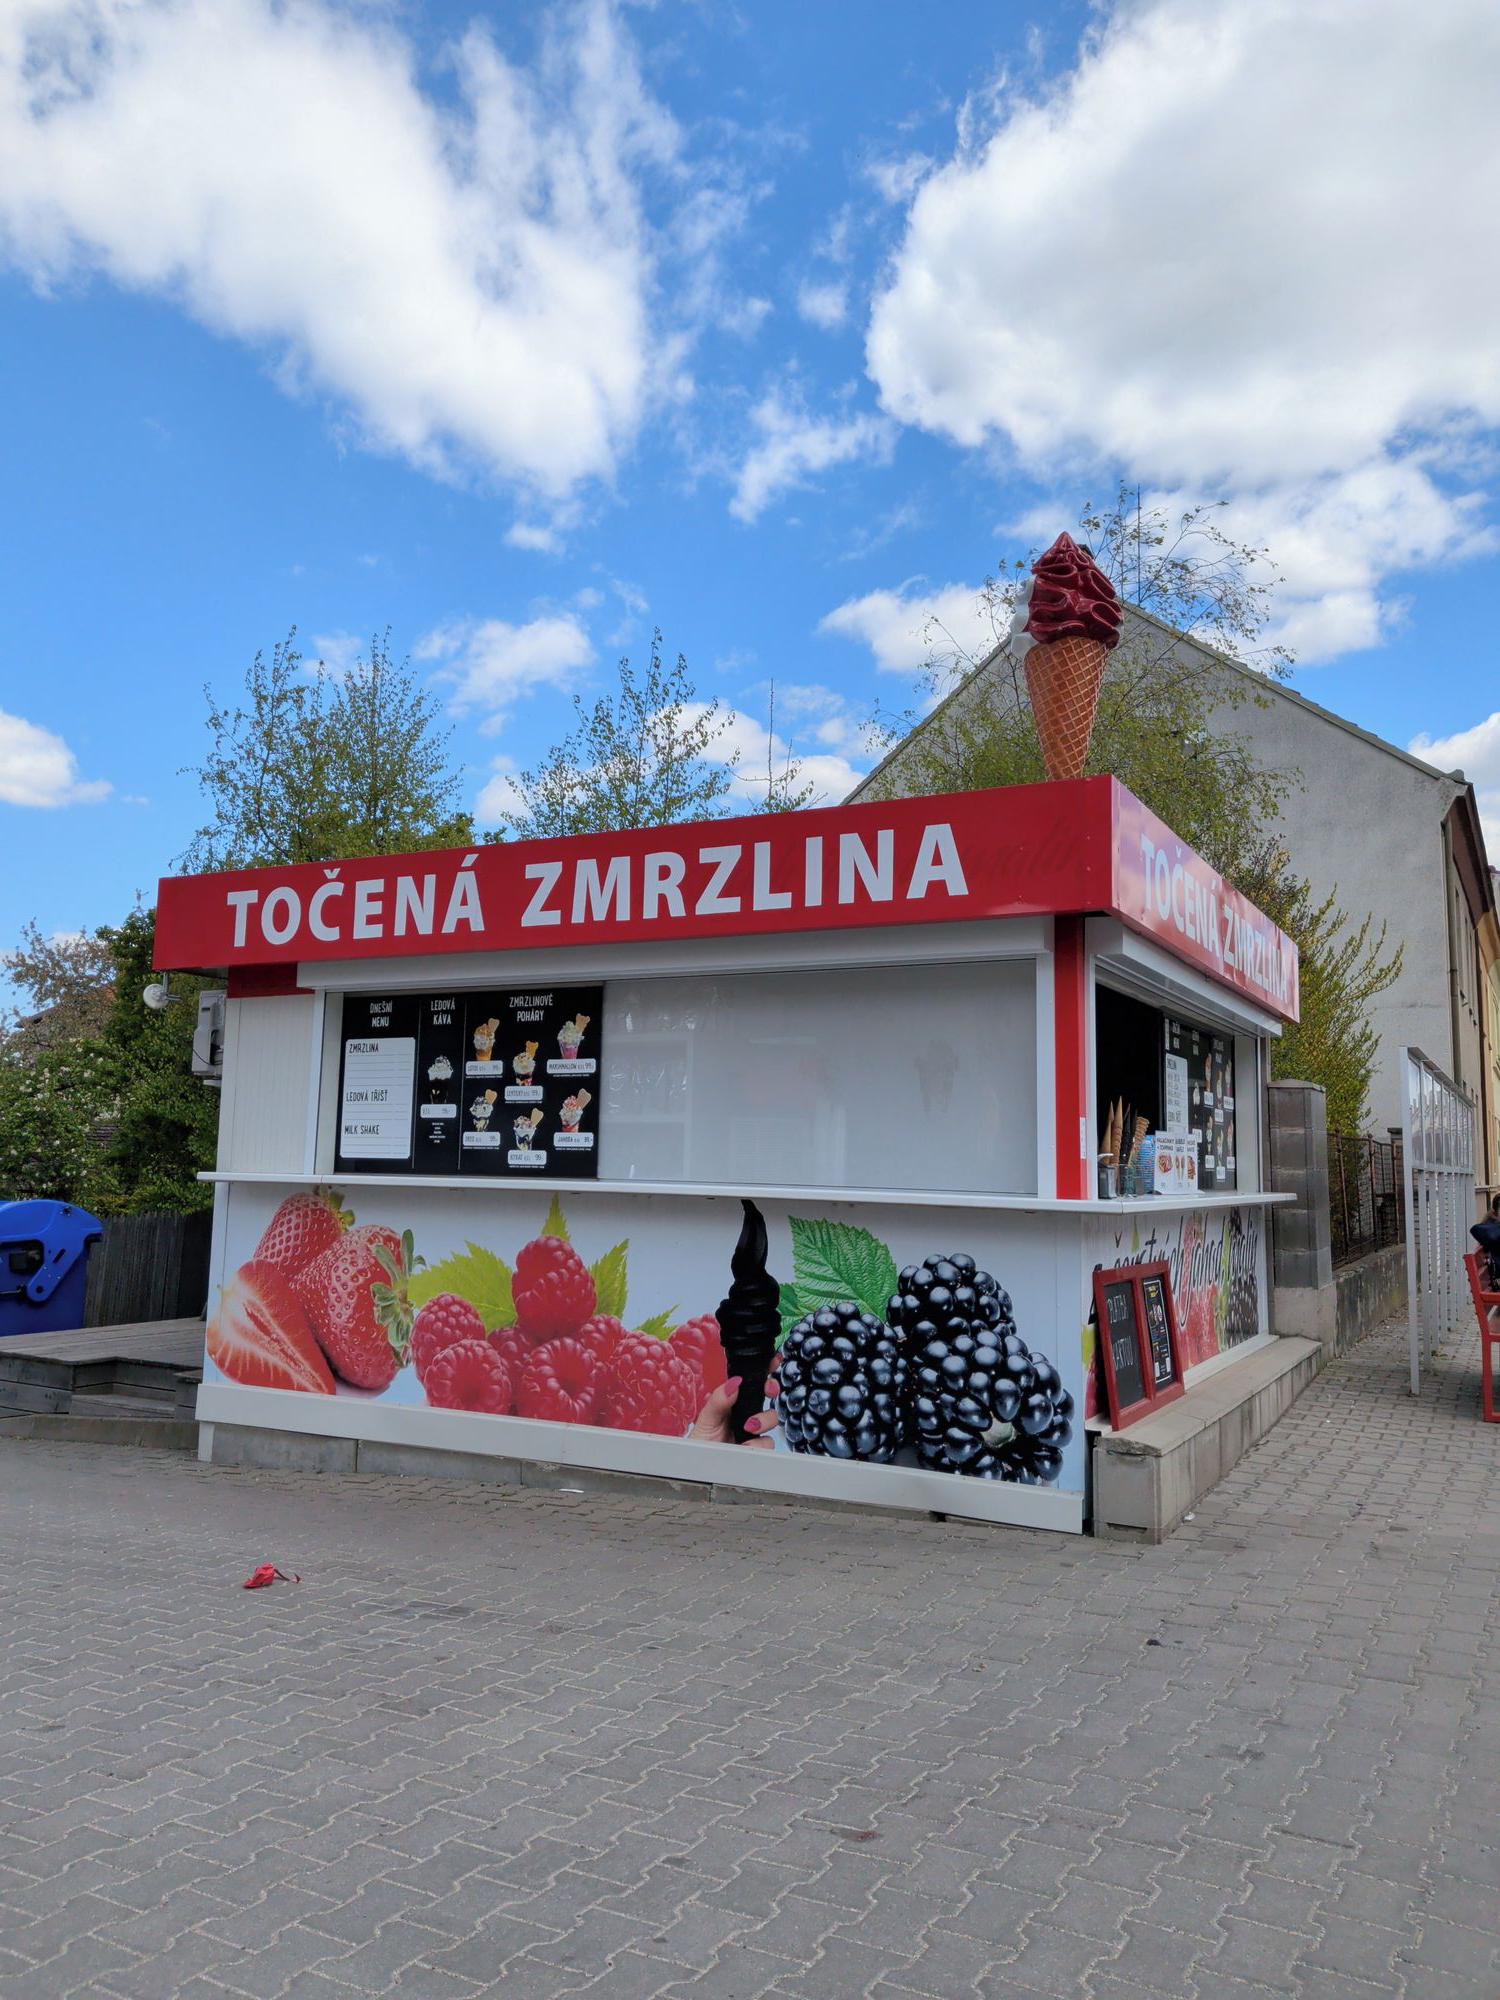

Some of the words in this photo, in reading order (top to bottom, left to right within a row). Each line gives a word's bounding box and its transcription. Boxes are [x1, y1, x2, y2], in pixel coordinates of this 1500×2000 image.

[227, 853, 486, 948] TOČENÁ
[520, 823, 969, 928] ZMRZLINA
[1140, 833, 1220, 958] TOČENÁ
[1222, 903, 1289, 1004] ZMRZLINA
[369, 1000, 393, 1014] DNEŠNÍ
[430, 997, 456, 1011] LEDOVÁ
[509, 993, 554, 1008] ZMRZLINOVÉ
[371, 1016, 390, 1028] MENU
[432, 1012, 452, 1025] KÁVA
[516, 1008, 545, 1022] POHÁRY
[348, 1042, 380, 1054] ZMRZLINA
[345, 1090, 369, 1102] LEDOVÁ
[344, 1123, 358, 1135] MILK
[360, 1124, 380, 1135] SHAKE
